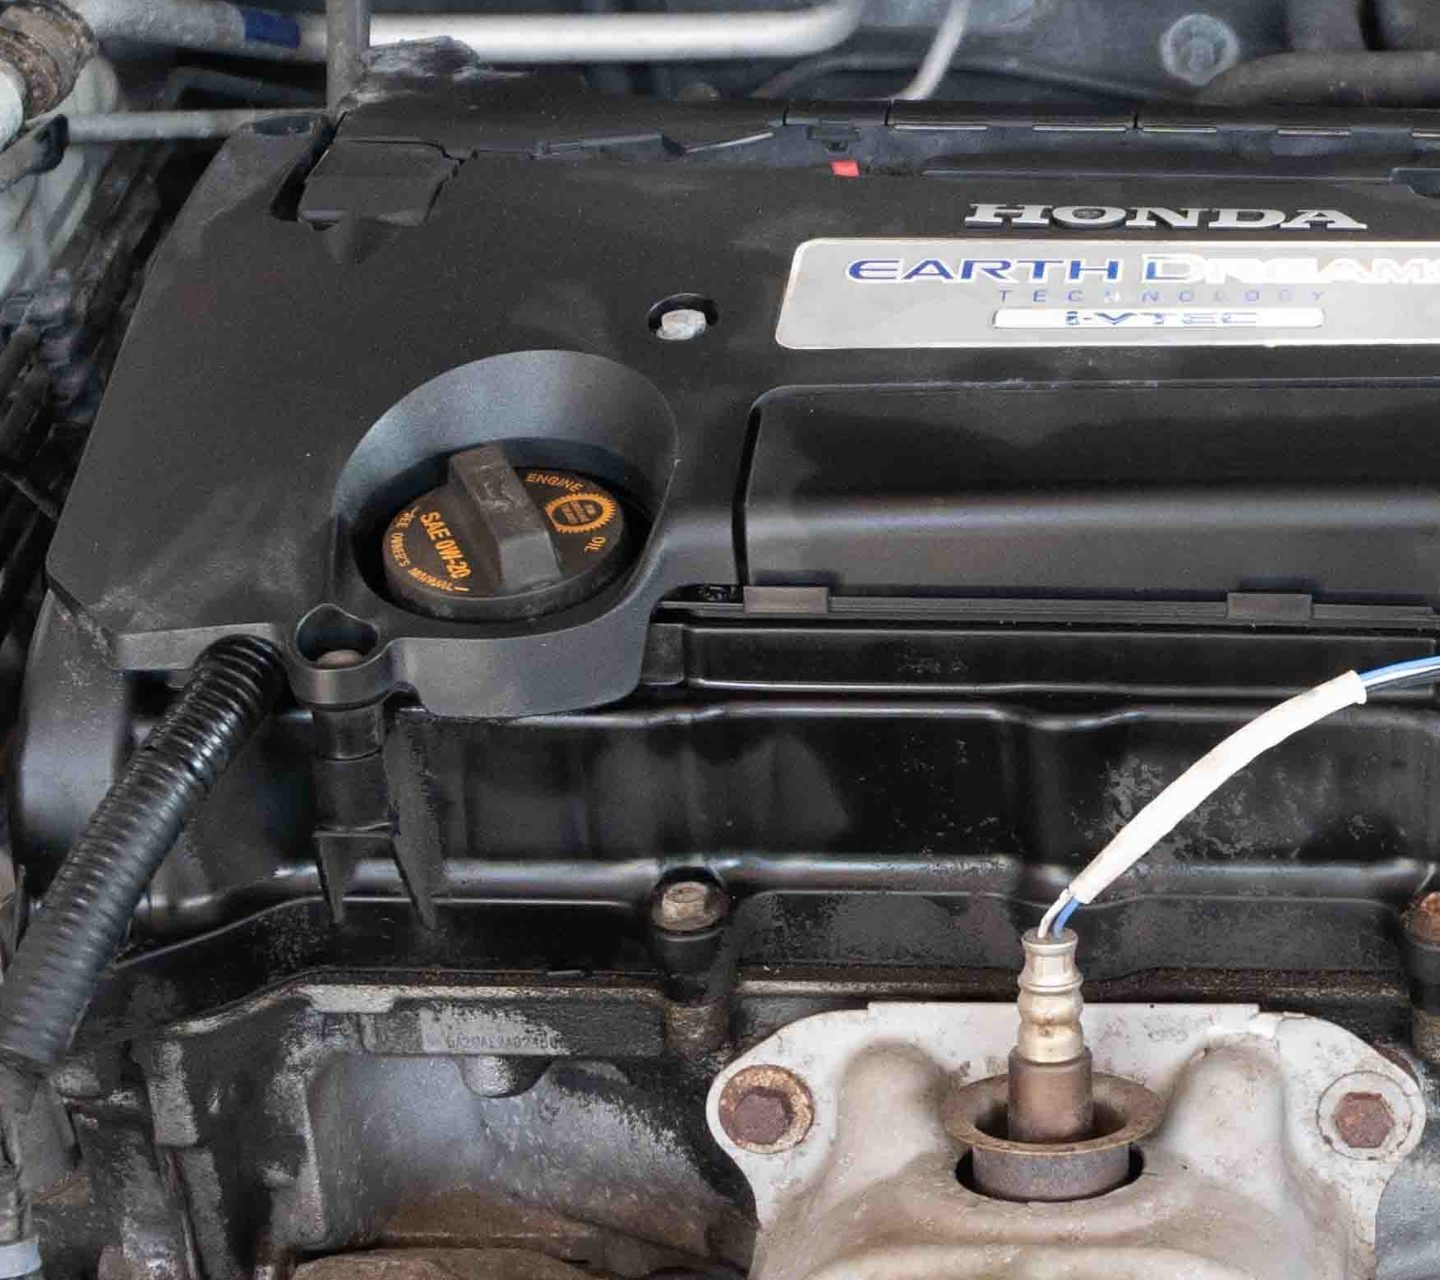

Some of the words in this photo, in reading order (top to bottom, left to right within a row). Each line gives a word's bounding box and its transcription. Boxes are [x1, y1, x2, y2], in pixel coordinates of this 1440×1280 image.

[964, 203, 1368, 230] HONDA
[847, 259, 1122, 282] EARTH
[525, 473, 585, 492] ENGINE
[420, 511, 450, 540] SAE
[435, 539, 473, 580] 0W-20
[584, 536, 606, 553] OIL
